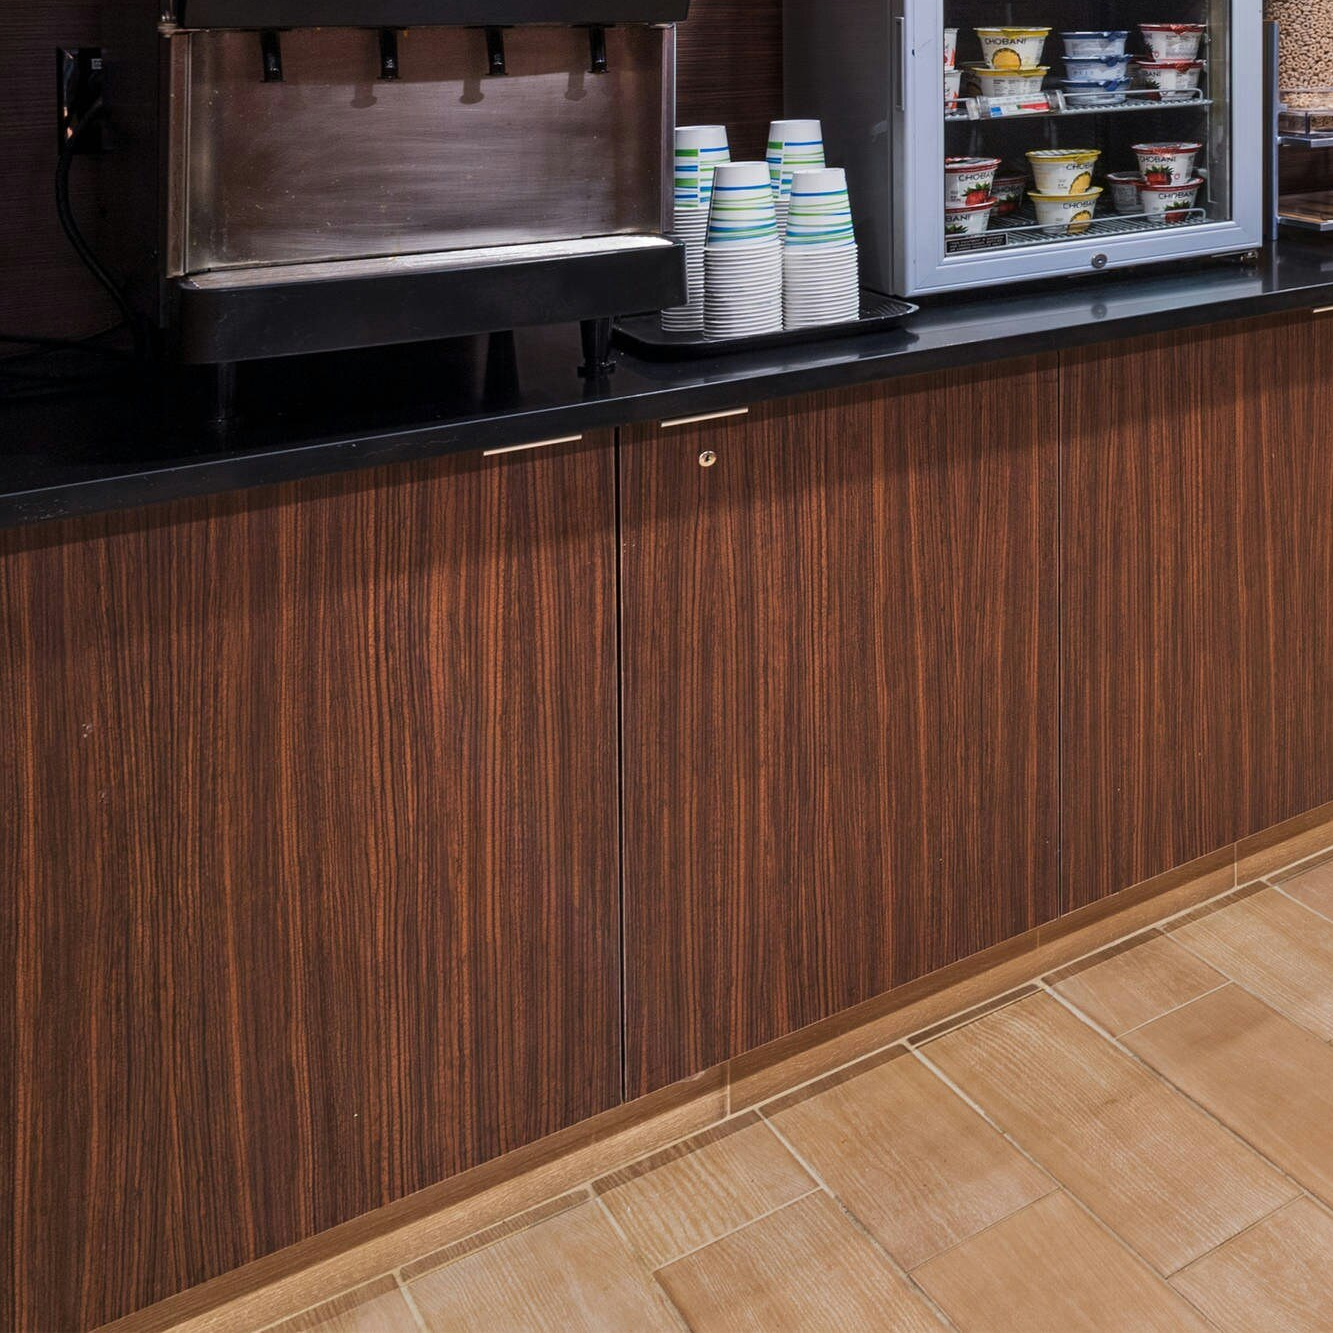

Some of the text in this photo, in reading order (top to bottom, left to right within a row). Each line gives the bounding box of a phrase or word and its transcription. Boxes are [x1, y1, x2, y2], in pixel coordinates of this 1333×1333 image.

[984, 37, 1027, 45] CHOBANI
[958, 170, 995, 182] CHOBAN
[1158, 192, 1194, 200] CHOBAN
[1063, 200, 1095, 209] CHOBA
[945, 213, 970, 223] BANI
